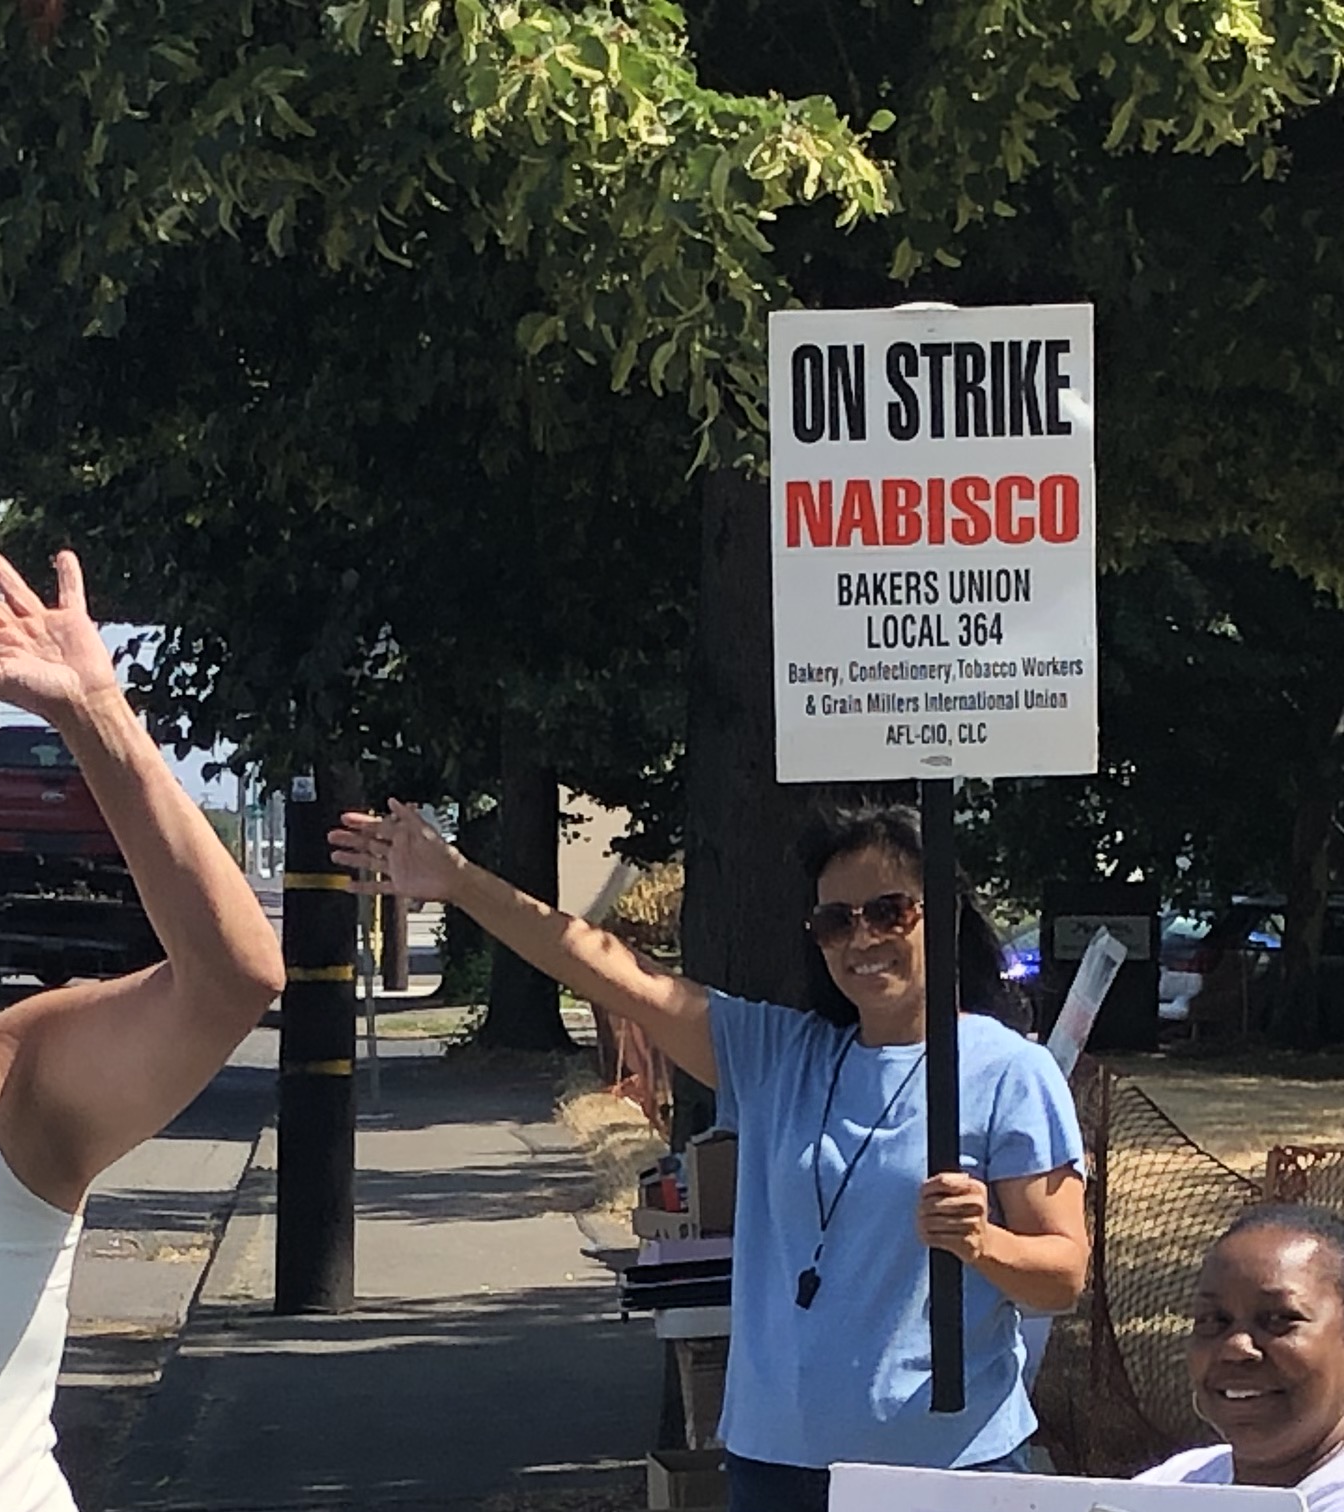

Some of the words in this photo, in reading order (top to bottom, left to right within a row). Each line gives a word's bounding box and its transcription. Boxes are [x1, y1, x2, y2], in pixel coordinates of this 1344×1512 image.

[791, 343, 867, 444] ON
[885, 339, 1073, 442] STRIKE
[785, 473, 1080, 549] NABISCO
[836, 570, 940, 607] BAKERS
[948, 568, 1031, 604] UNION
[866, 613, 950, 649] LOCAL
[958, 612, 1003, 646] 364
[788, 661, 844, 688] Bakery,
[848, 660, 956, 684] Confectionery,
[957, 658, 1017, 679] Tobacco
[1021, 656, 1084, 677] Workers
[805, 694, 816, 716] &
[821, 694, 863, 716] Grain
[867, 692, 920, 714] Millers
[924, 689, 1020, 713] International
[1024, 688, 1069, 710] Union
[885, 722, 953, 747] AFL-CIO,
[958, 722, 988, 744] CLC
